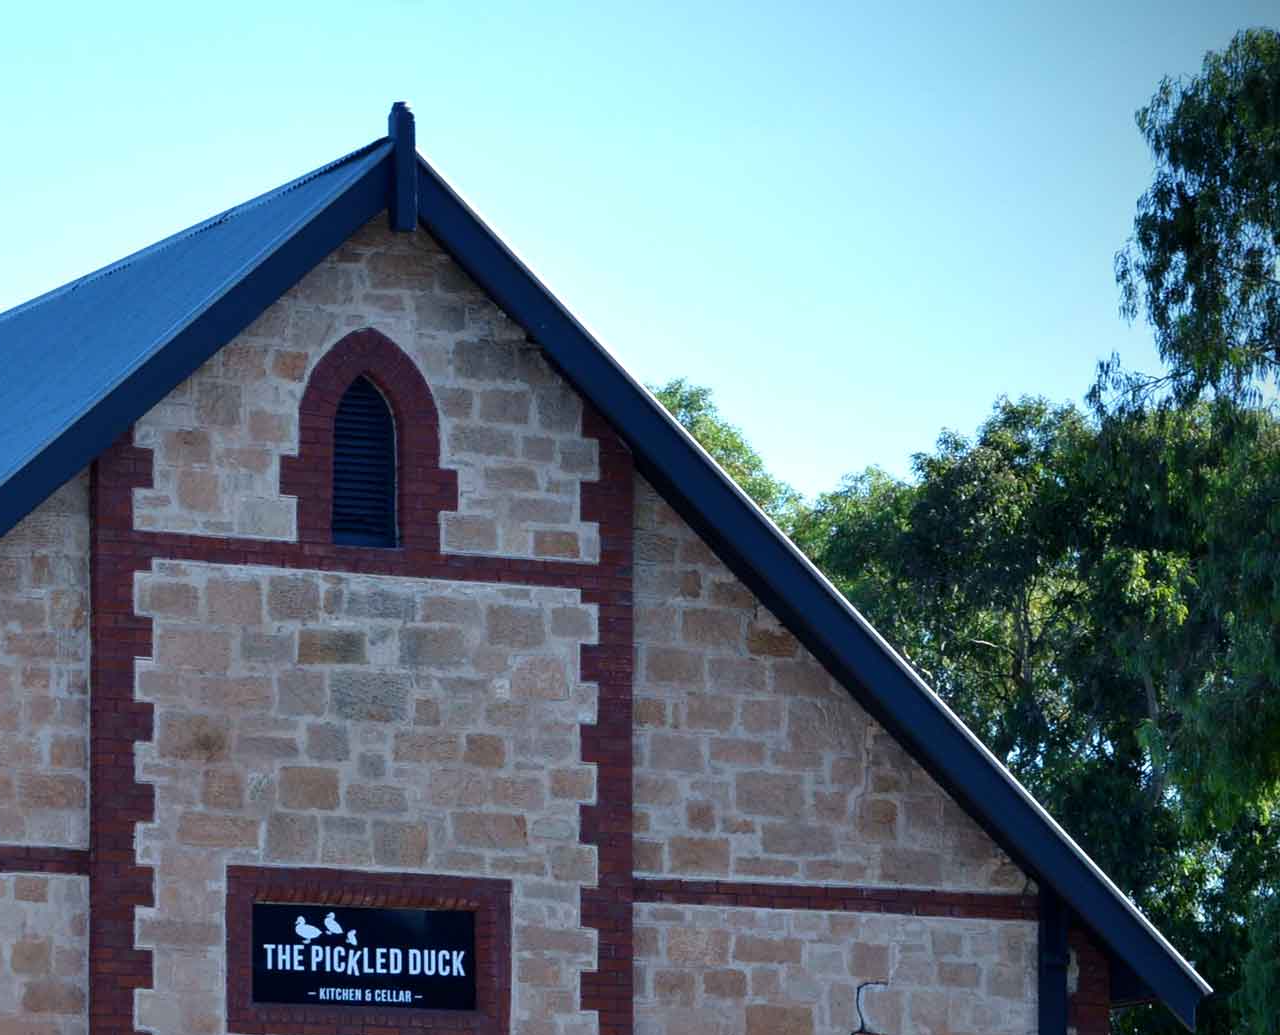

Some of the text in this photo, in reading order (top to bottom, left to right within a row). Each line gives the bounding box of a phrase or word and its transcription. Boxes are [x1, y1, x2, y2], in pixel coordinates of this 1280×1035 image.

[263, 943, 466, 977] THE PICKLED DUCK
[319, 987, 412, 1003] KITCHEN & CELLAR
